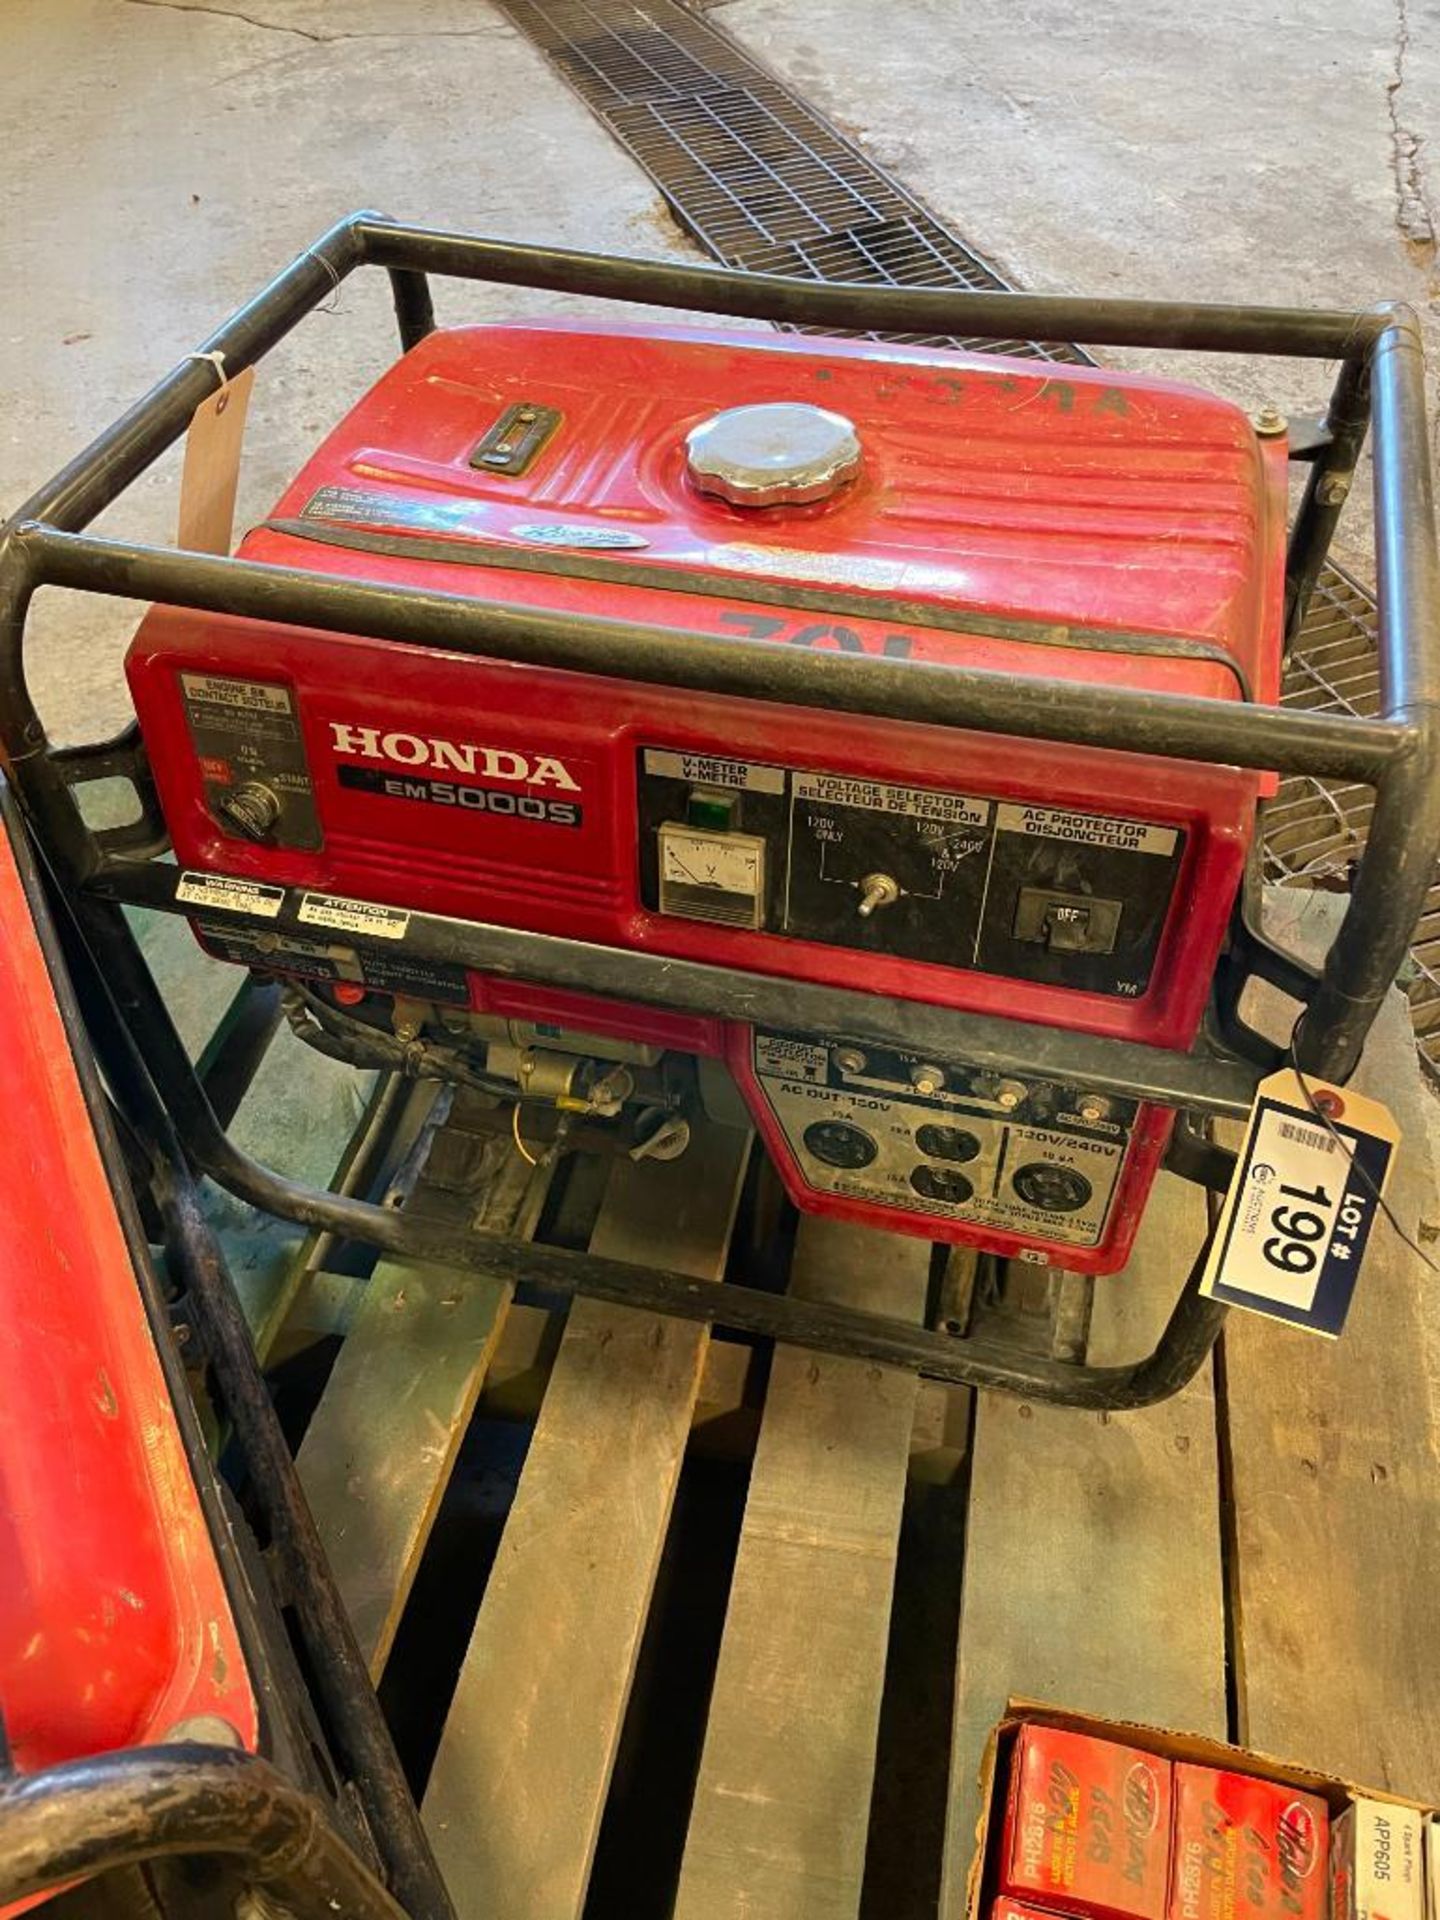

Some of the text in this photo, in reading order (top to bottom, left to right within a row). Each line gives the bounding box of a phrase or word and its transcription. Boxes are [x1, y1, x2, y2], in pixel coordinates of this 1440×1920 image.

[188, 688, 241, 708] CONTACT
[329, 722, 581, 792] HONDA
[682, 757, 749, 776] V-METER
[682, 768, 748, 787] V-METRE
[817, 778, 966, 811] VOLTAGE SELECTOR
[799, 787, 982, 823] SELECTEUR DE TENSION
[807, 816, 835, 831] 120V
[916, 822, 945, 836] 120V
[1023, 809, 1147, 838] AC PROTECTOR
[1024, 822, 1140, 849] DISJONCTEUR
[931, 857, 959, 872] 120V
[204, 878, 260, 896] WARNING
[322, 897, 390, 917] ATTENTION
[1056, 908, 1079, 923] OFF
[780, 1084, 807, 1097] AC
[809, 1088, 842, 1104] OUT
[1015, 1129, 1117, 1157] 120V/240V
[1263, 1184, 1332, 1275] 199
[1329, 1193, 1367, 1260] LOT #
[1372, 1815, 1391, 1882] APP605
